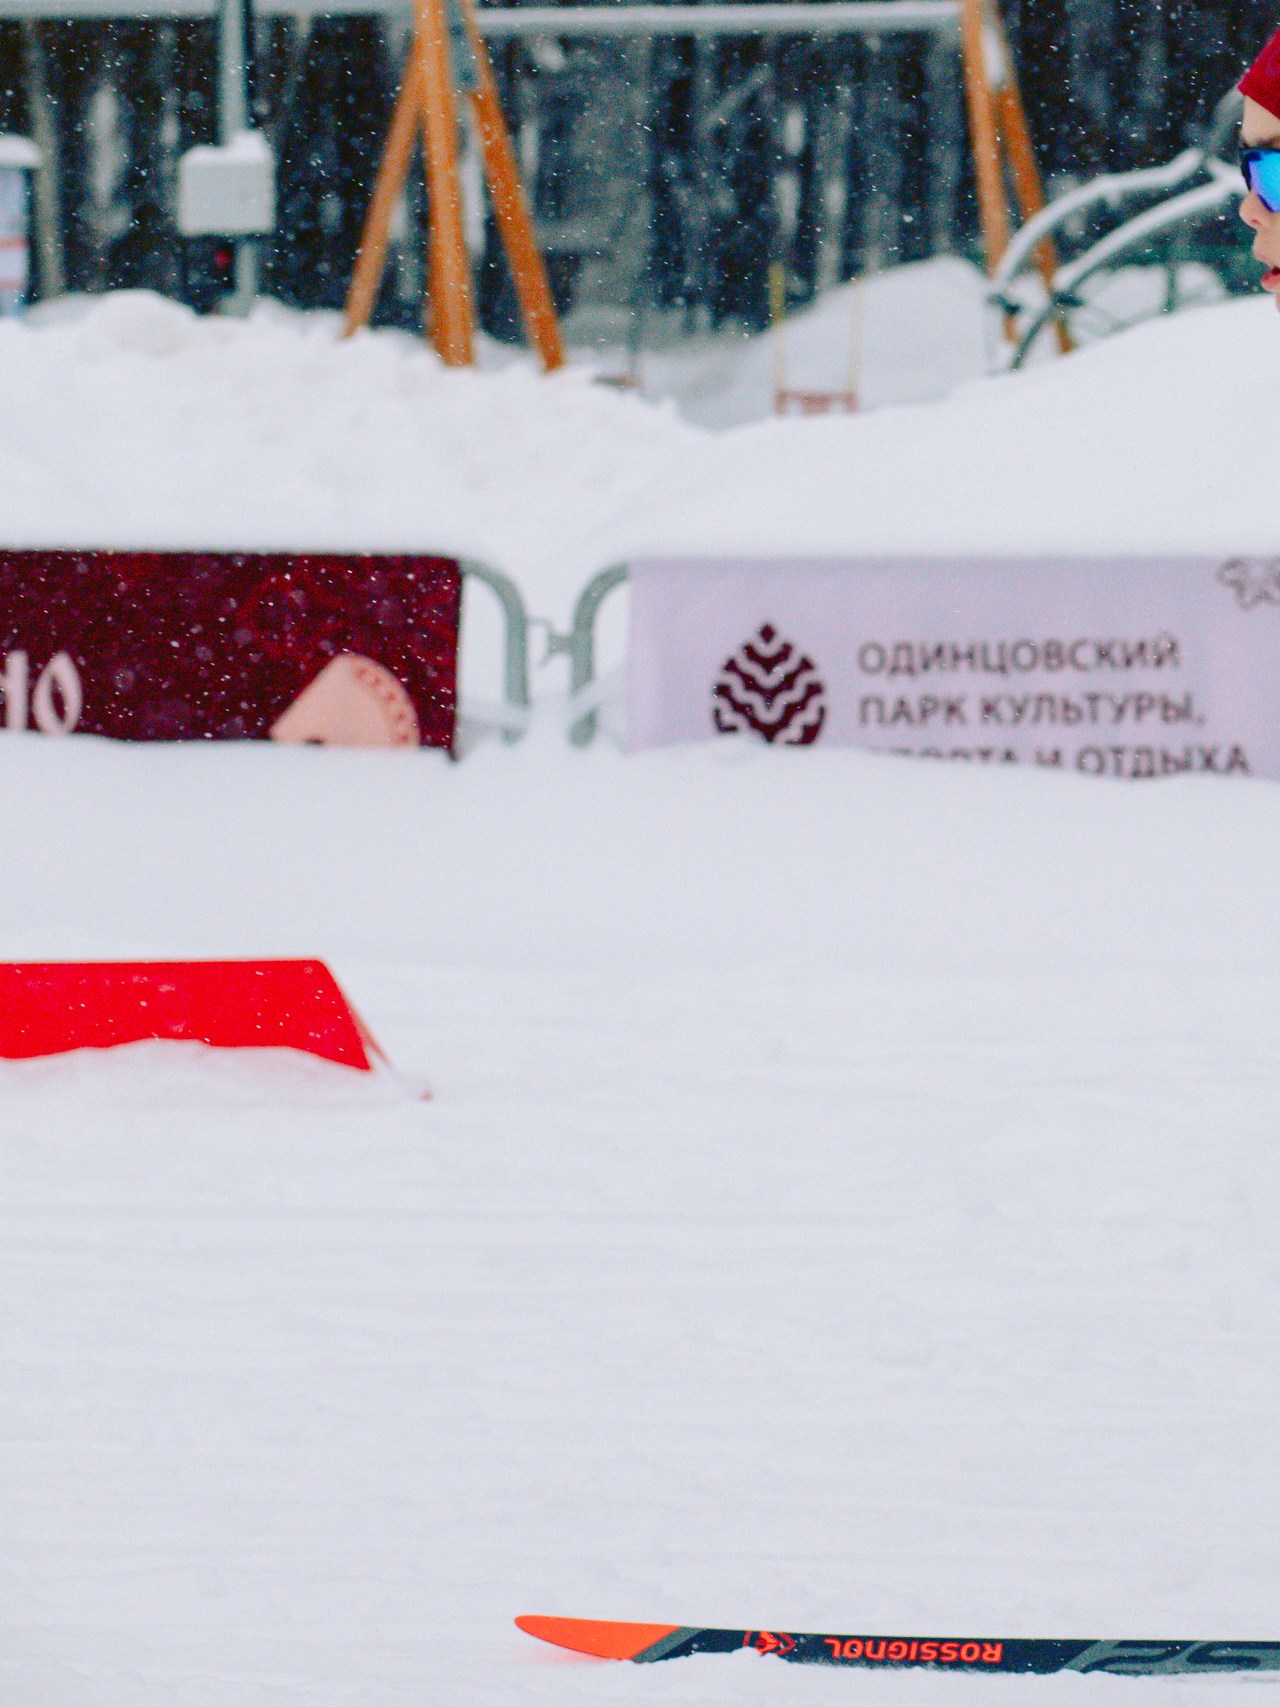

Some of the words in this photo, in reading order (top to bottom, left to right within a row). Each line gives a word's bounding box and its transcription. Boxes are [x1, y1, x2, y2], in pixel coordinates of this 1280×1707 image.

[857, 632, 1180, 677] ОДИНЦОВСКИЙ
[859, 692, 966, 726] ПАРК
[979, 691, 1206, 727] КУЛЬТУРЫ,
[1076, 744, 1251, 779] ОТДЫХА
[824, 1637, 1002, 1664] ROSSIGNOL
